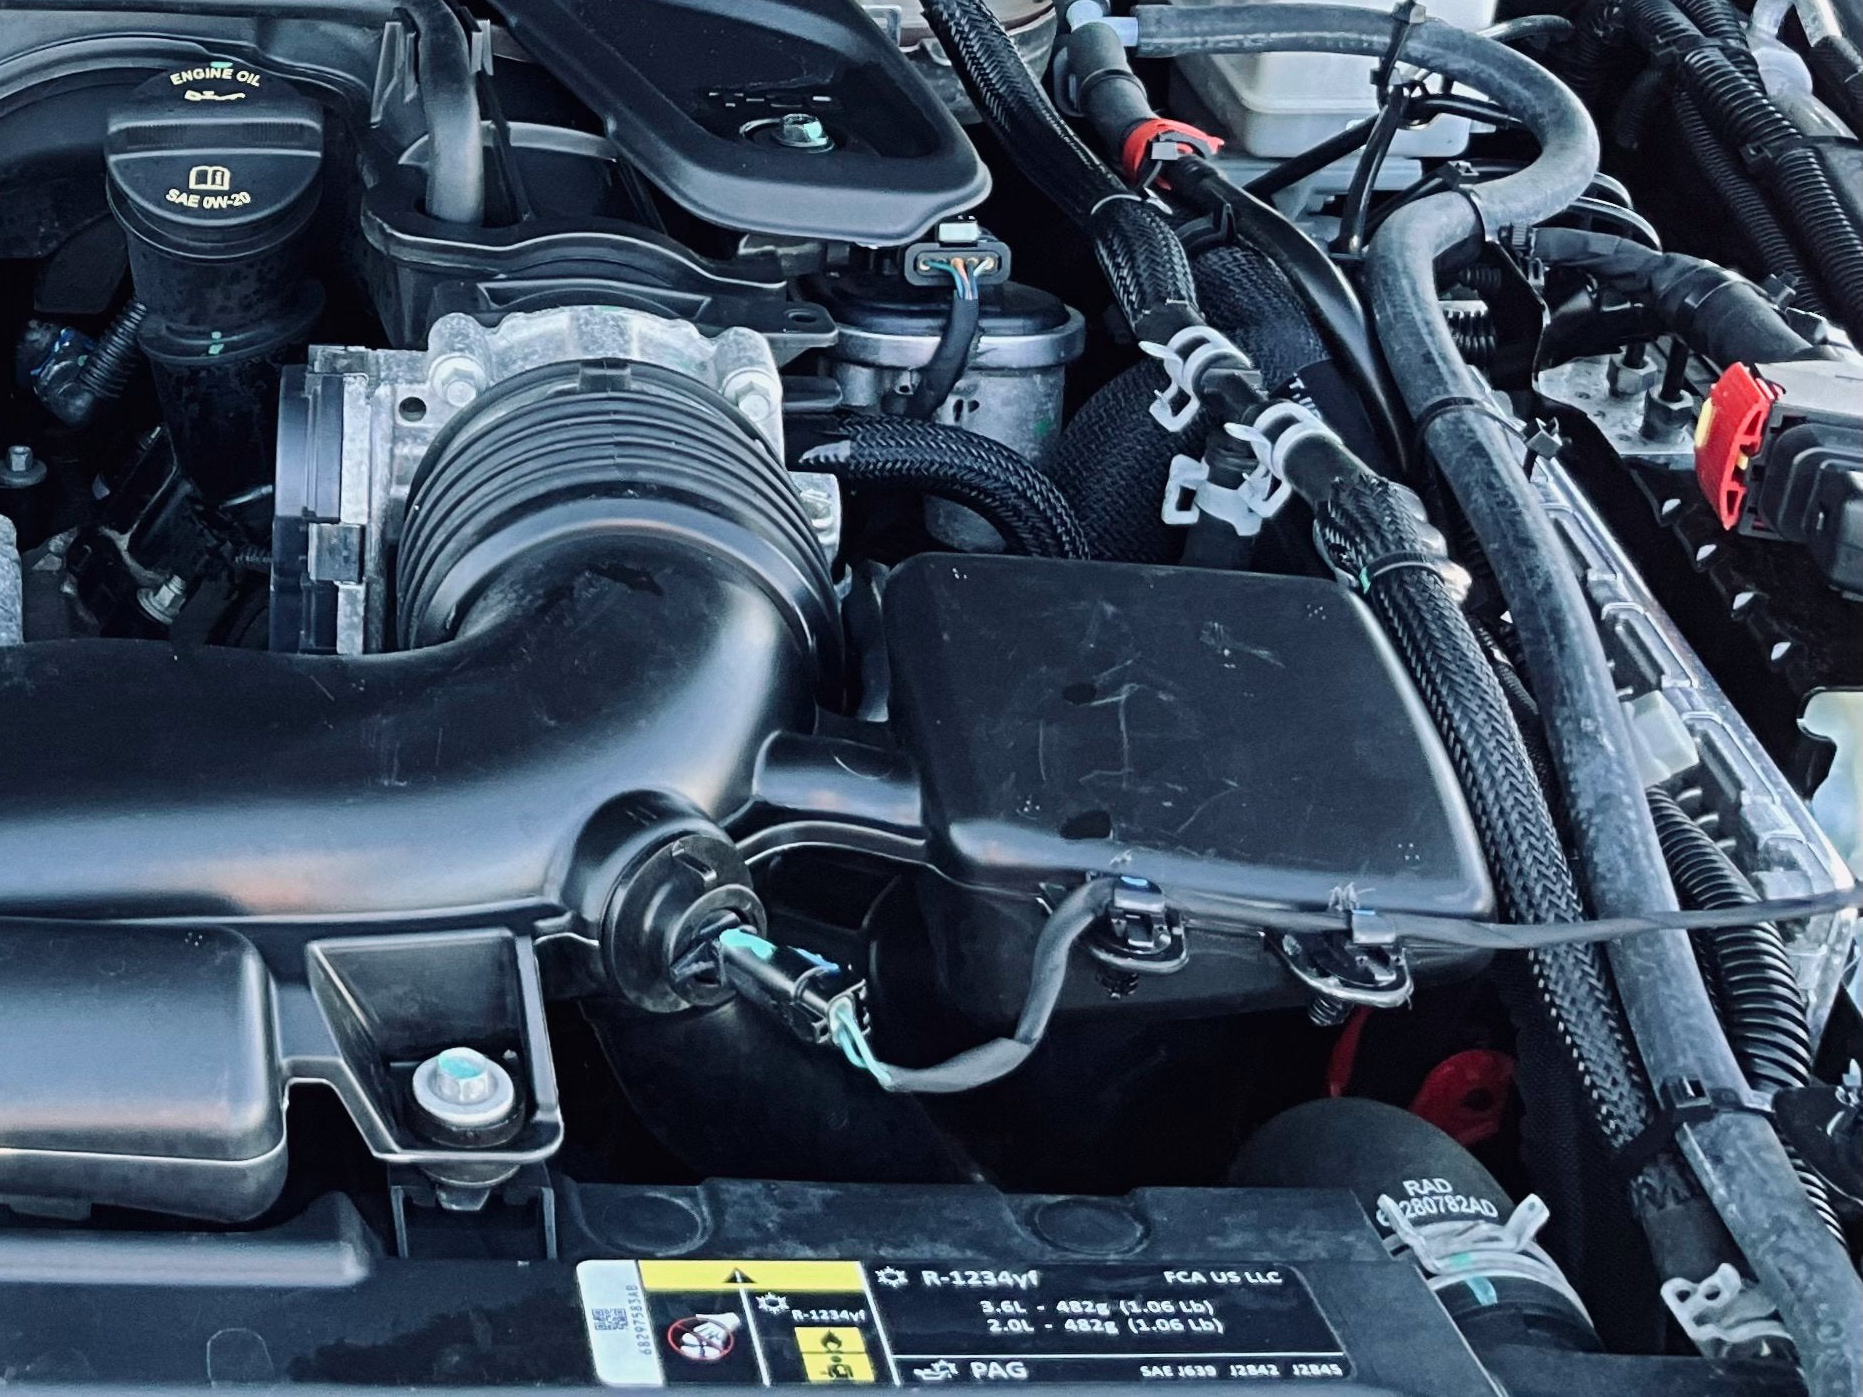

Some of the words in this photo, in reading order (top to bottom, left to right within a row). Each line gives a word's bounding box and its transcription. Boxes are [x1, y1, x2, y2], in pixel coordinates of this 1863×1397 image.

[169, 68, 233, 86] ENGINE
[236, 70, 261, 87] OIL
[165, 188, 199, 208] SAE
[202, 191, 252, 209] 0W-20
[1403, 1178, 1452, 1196] RAD
[1376, 1195, 1499, 1227] 280782AD
[921, 1269, 1039, 1290] R-1234yf
[1163, 1270, 1207, 1285] FCA
[1210, 1271, 1241, 1285] US
[1244, 1271, 1283, 1285] LLC
[980, 1300, 1027, 1314] 3.6L
[1056, 1300, 1110, 1316] 482g
[1119, 1300, 1174, 1315] (1.06
[1179, 1300, 1214, 1316] Lb)
[986, 1318, 1035, 1333] 2.0L
[1065, 1318, 1119, 1335] 482g
[1127, 1318, 1184, 1334] (1.06
[1188, 1318, 1224, 1334] Lb)
[970, 1361, 1028, 1380] PAG
[1140, 1365, 1173, 1378] SAE
[1230, 1364, 1280, 1378] J2842
